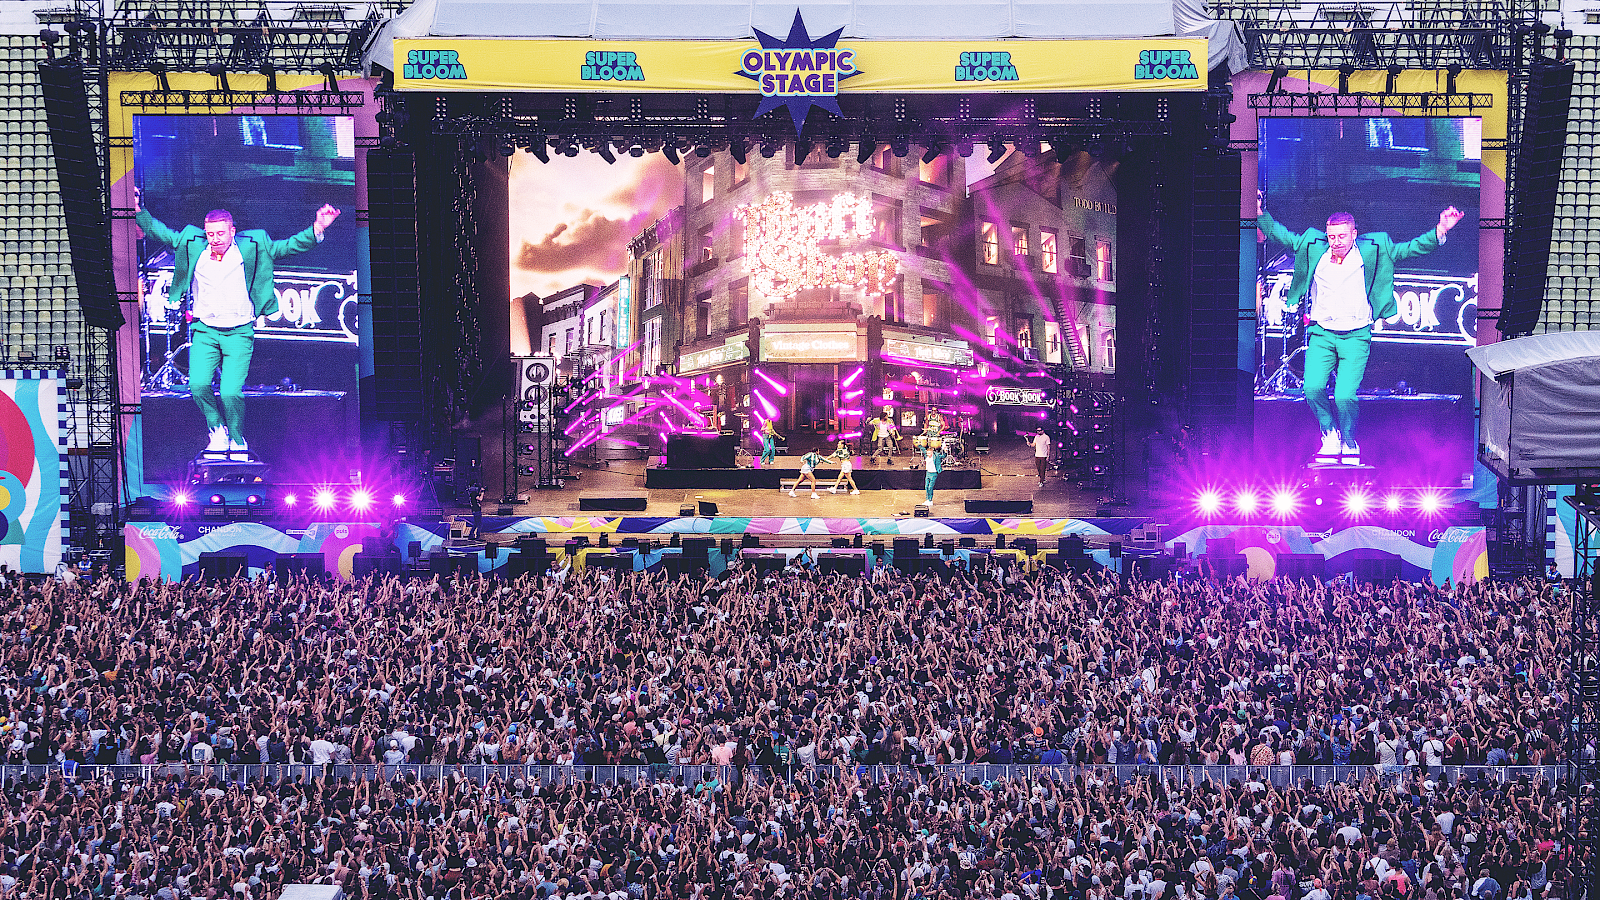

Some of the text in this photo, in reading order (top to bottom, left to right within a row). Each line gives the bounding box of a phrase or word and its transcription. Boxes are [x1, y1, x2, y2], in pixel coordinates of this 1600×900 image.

[408, 50, 459, 64] SUPER
[586, 51, 637, 66] SUPER
[743, 51, 854, 71] OLYMPIC
[960, 51, 1011, 66] SUPER
[1139, 50, 1191, 64] SUPER
[403, 64, 467, 79] BLOOM
[581, 65, 645, 80] BLOOM
[955, 66, 1019, 81] BLOOM
[1135, 64, 1199, 79] BLOOM
[762, 74, 835, 93] STAGE
[752, 237, 899, 299] Shop
[619, 279, 630, 347] GALLERY
[772, 340, 849, 352] Vintage Clothes
[1000, 390, 1042, 403] BOOK NOOK
[198, 525, 242, 534] CHANDON
